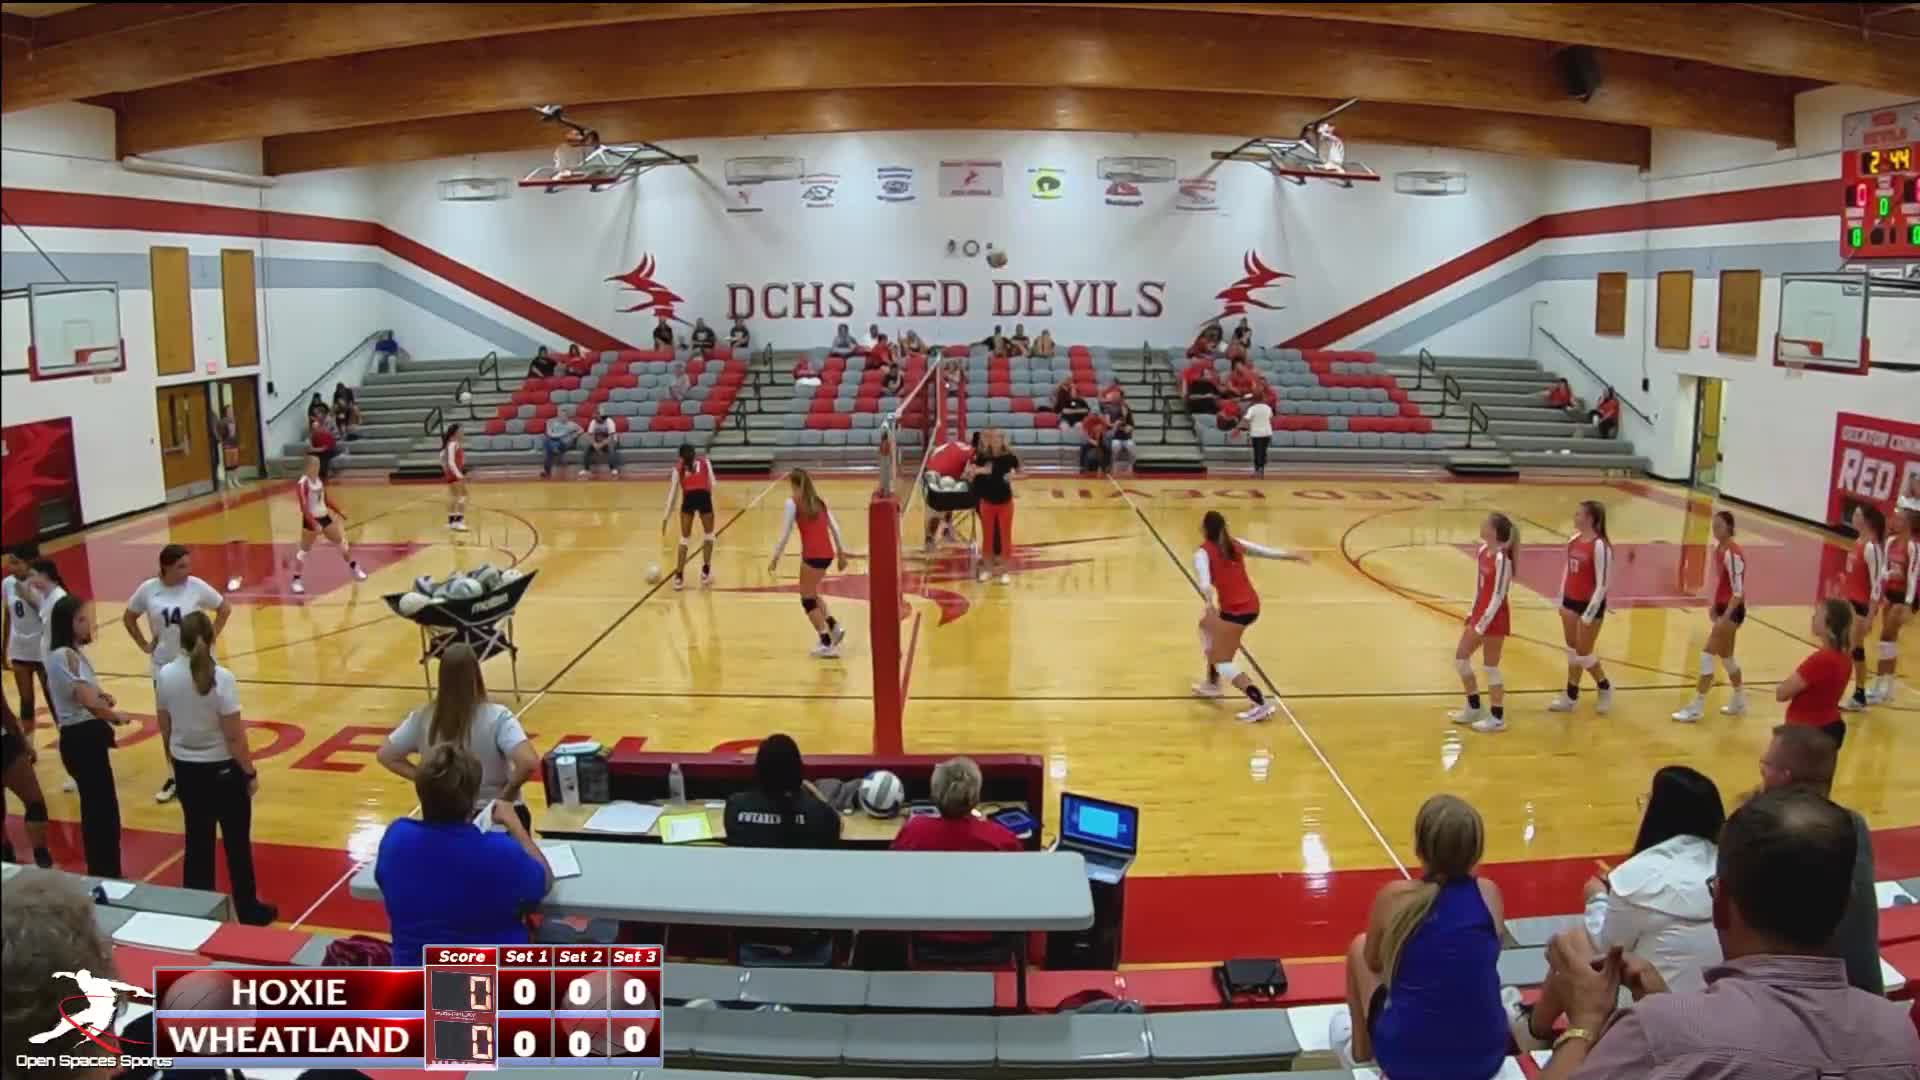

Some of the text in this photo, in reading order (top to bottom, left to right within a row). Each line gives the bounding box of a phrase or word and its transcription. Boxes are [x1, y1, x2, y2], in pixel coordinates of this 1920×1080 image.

[727, 281, 1166, 319] DCHS RED DEVILS
[1838, 447, 1896, 500] RED
[161, 606, 183, 627] 14
